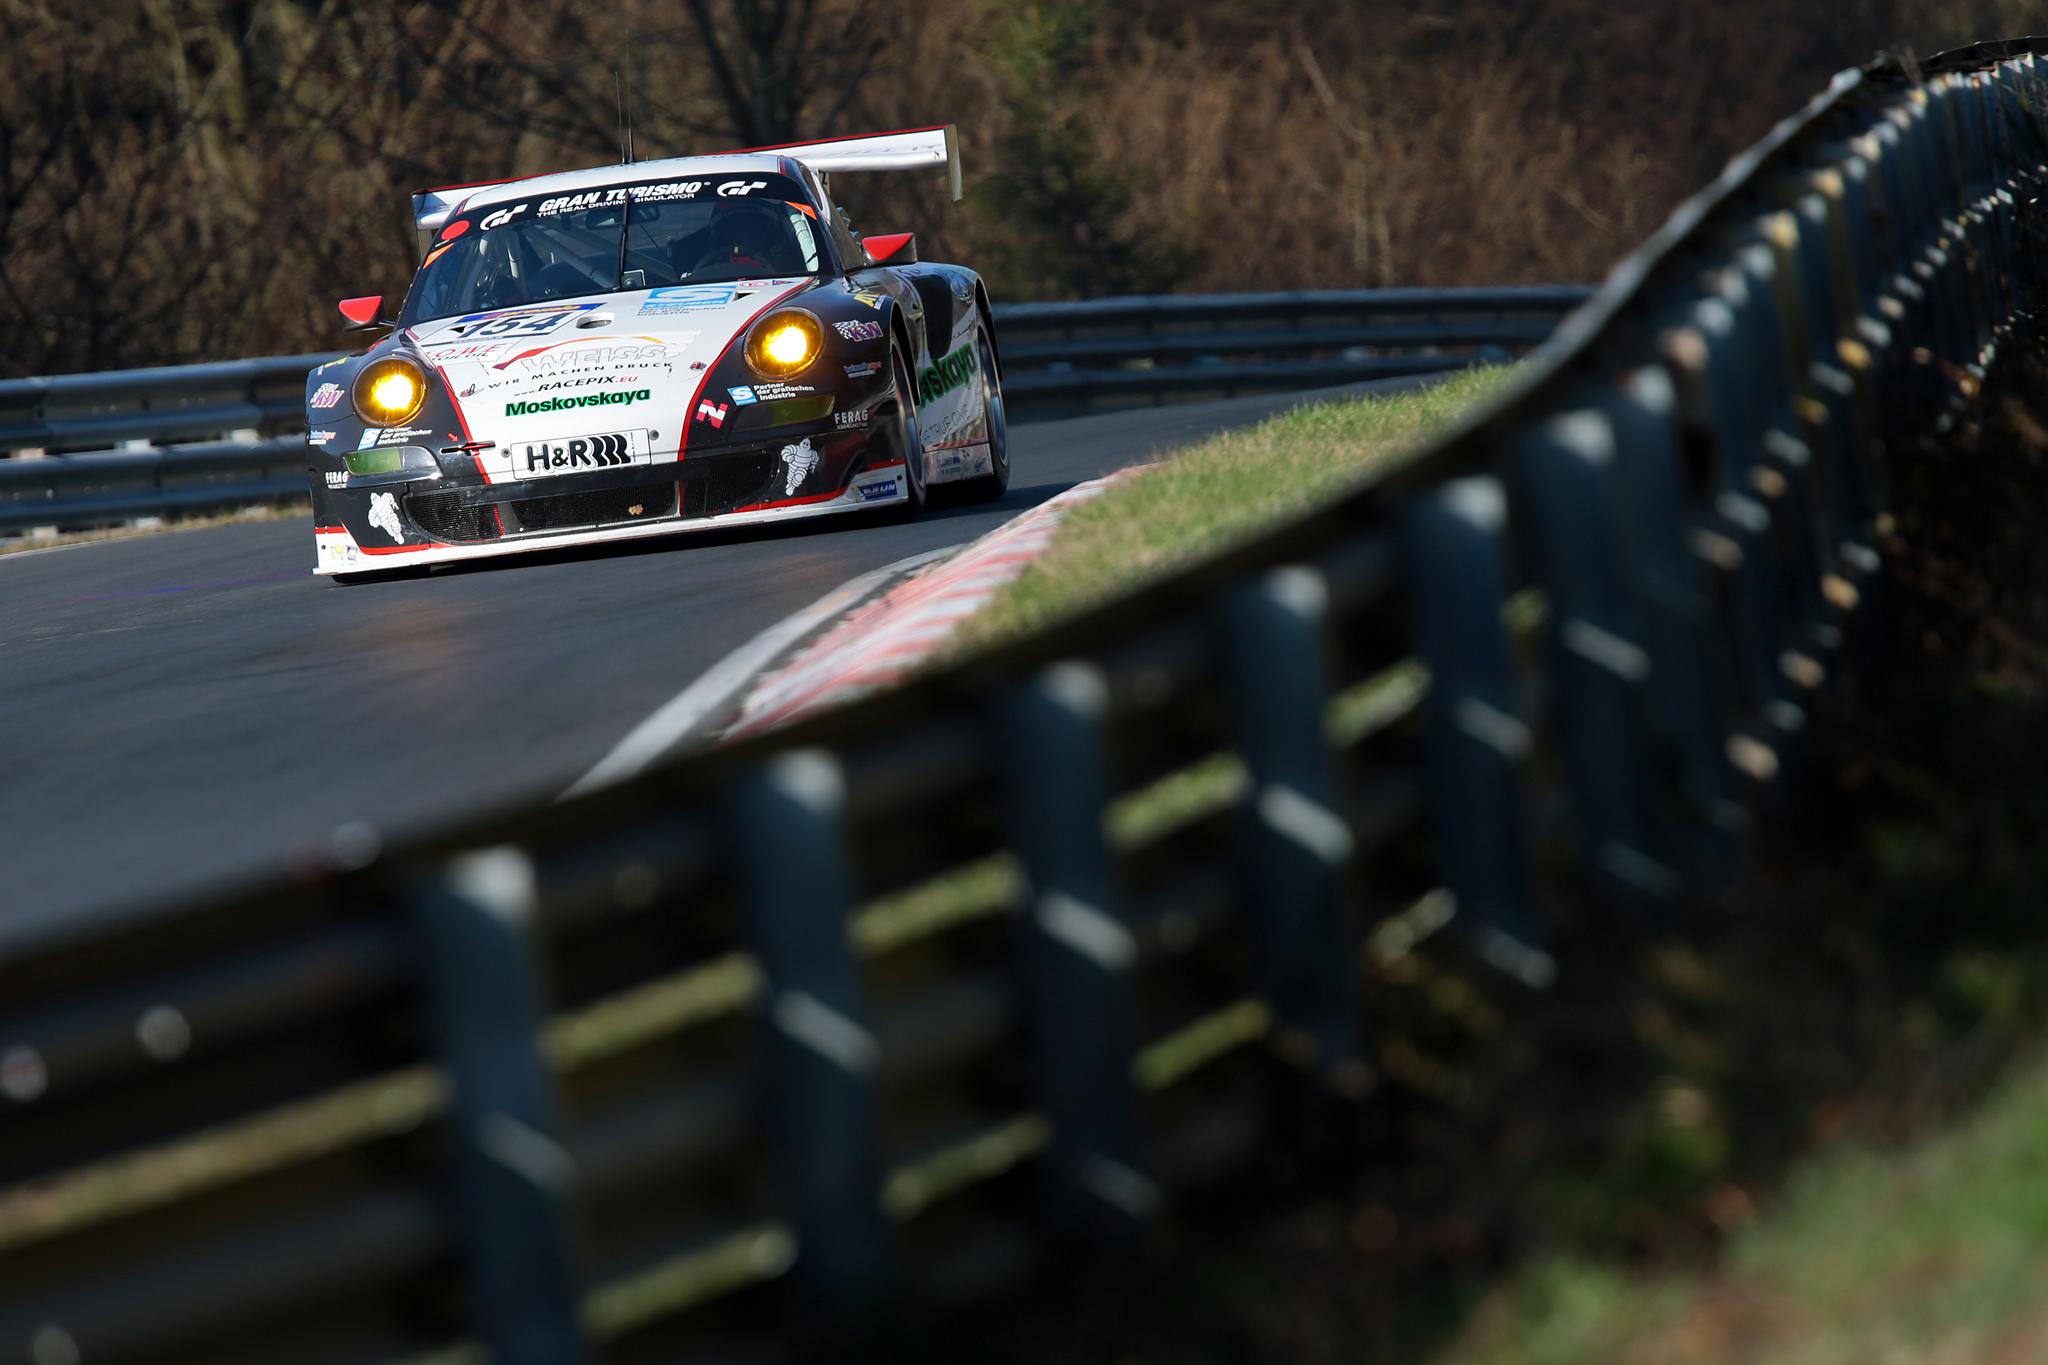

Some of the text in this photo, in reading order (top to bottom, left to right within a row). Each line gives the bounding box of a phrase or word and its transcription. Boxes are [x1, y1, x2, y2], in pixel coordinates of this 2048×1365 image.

[536, 193, 694, 217] THE REAL DRIVIN SIMULATOR
[538, 181, 702, 212] GRAN TURISMO
[457, 312, 574, 338] 154
[488, 378, 520, 389] WIR
[531, 366, 604, 381] MACHEN
[760, 392, 797, 400] Industrie
[772, 385, 815, 394] grafischen
[505, 389, 651, 417] Moskovskaya
[834, 410, 869, 424] FERAG
[527, 440, 592, 472] H&R
[325, 471, 349, 484] FERAG
